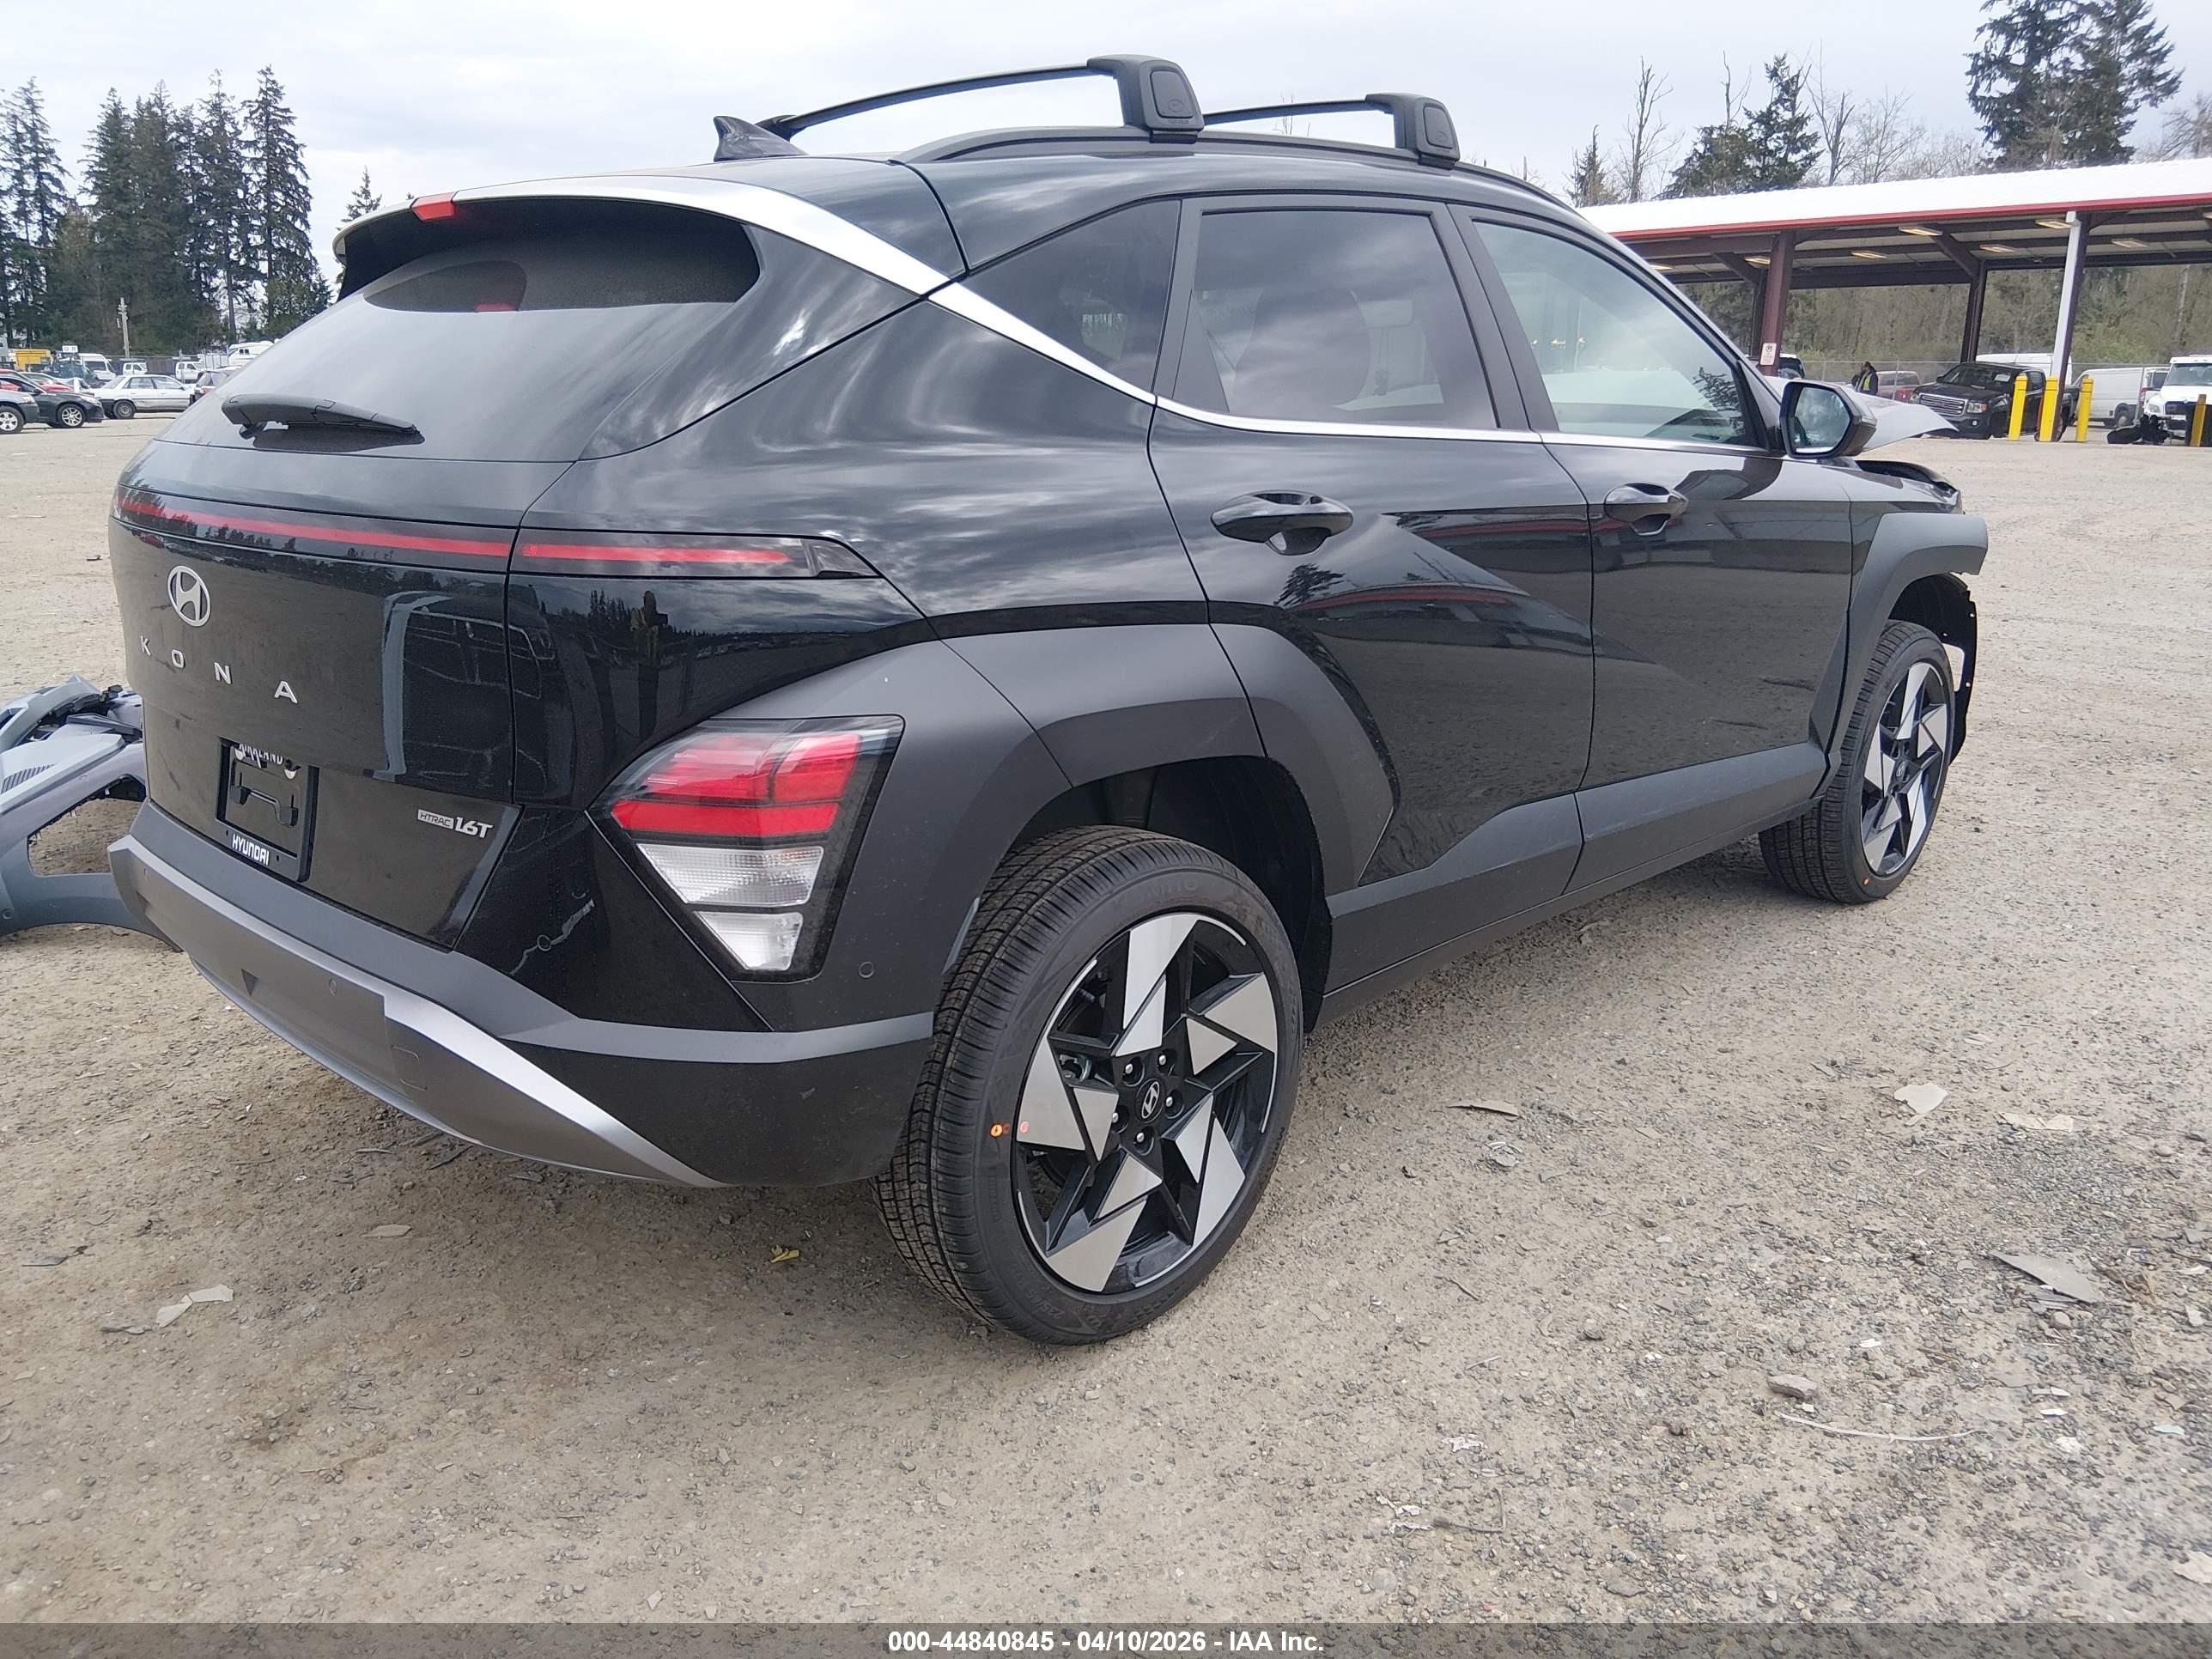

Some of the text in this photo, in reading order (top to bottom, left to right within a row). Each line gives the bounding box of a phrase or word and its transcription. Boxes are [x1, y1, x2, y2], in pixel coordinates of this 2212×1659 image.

[140, 635, 298, 704] KONA
[420, 811, 452, 827] HTRAC
[232, 833, 270, 866] HYUNDAI
